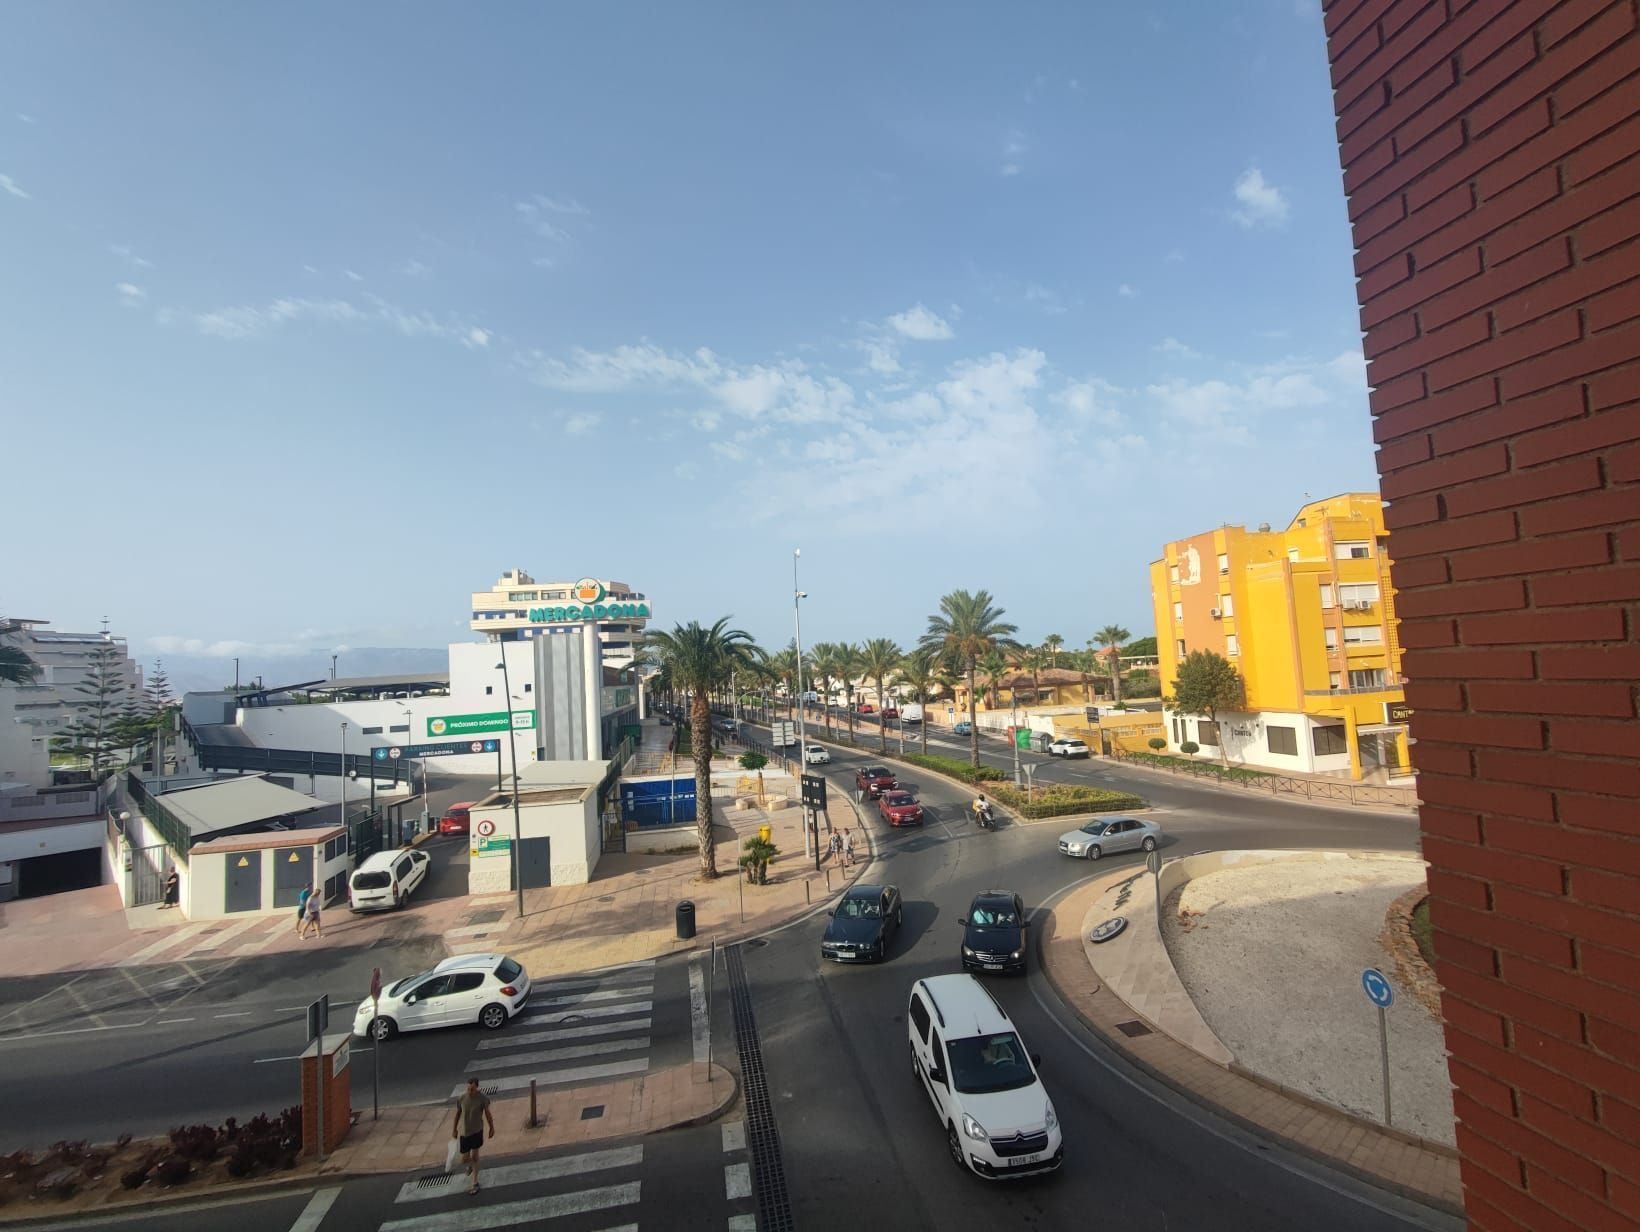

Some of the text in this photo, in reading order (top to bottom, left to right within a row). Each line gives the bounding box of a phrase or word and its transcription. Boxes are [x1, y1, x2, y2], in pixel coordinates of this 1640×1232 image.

[529, 603, 649, 622] MERCADONA
[451, 718, 509, 728] PRÓXIMO DOMINGO
